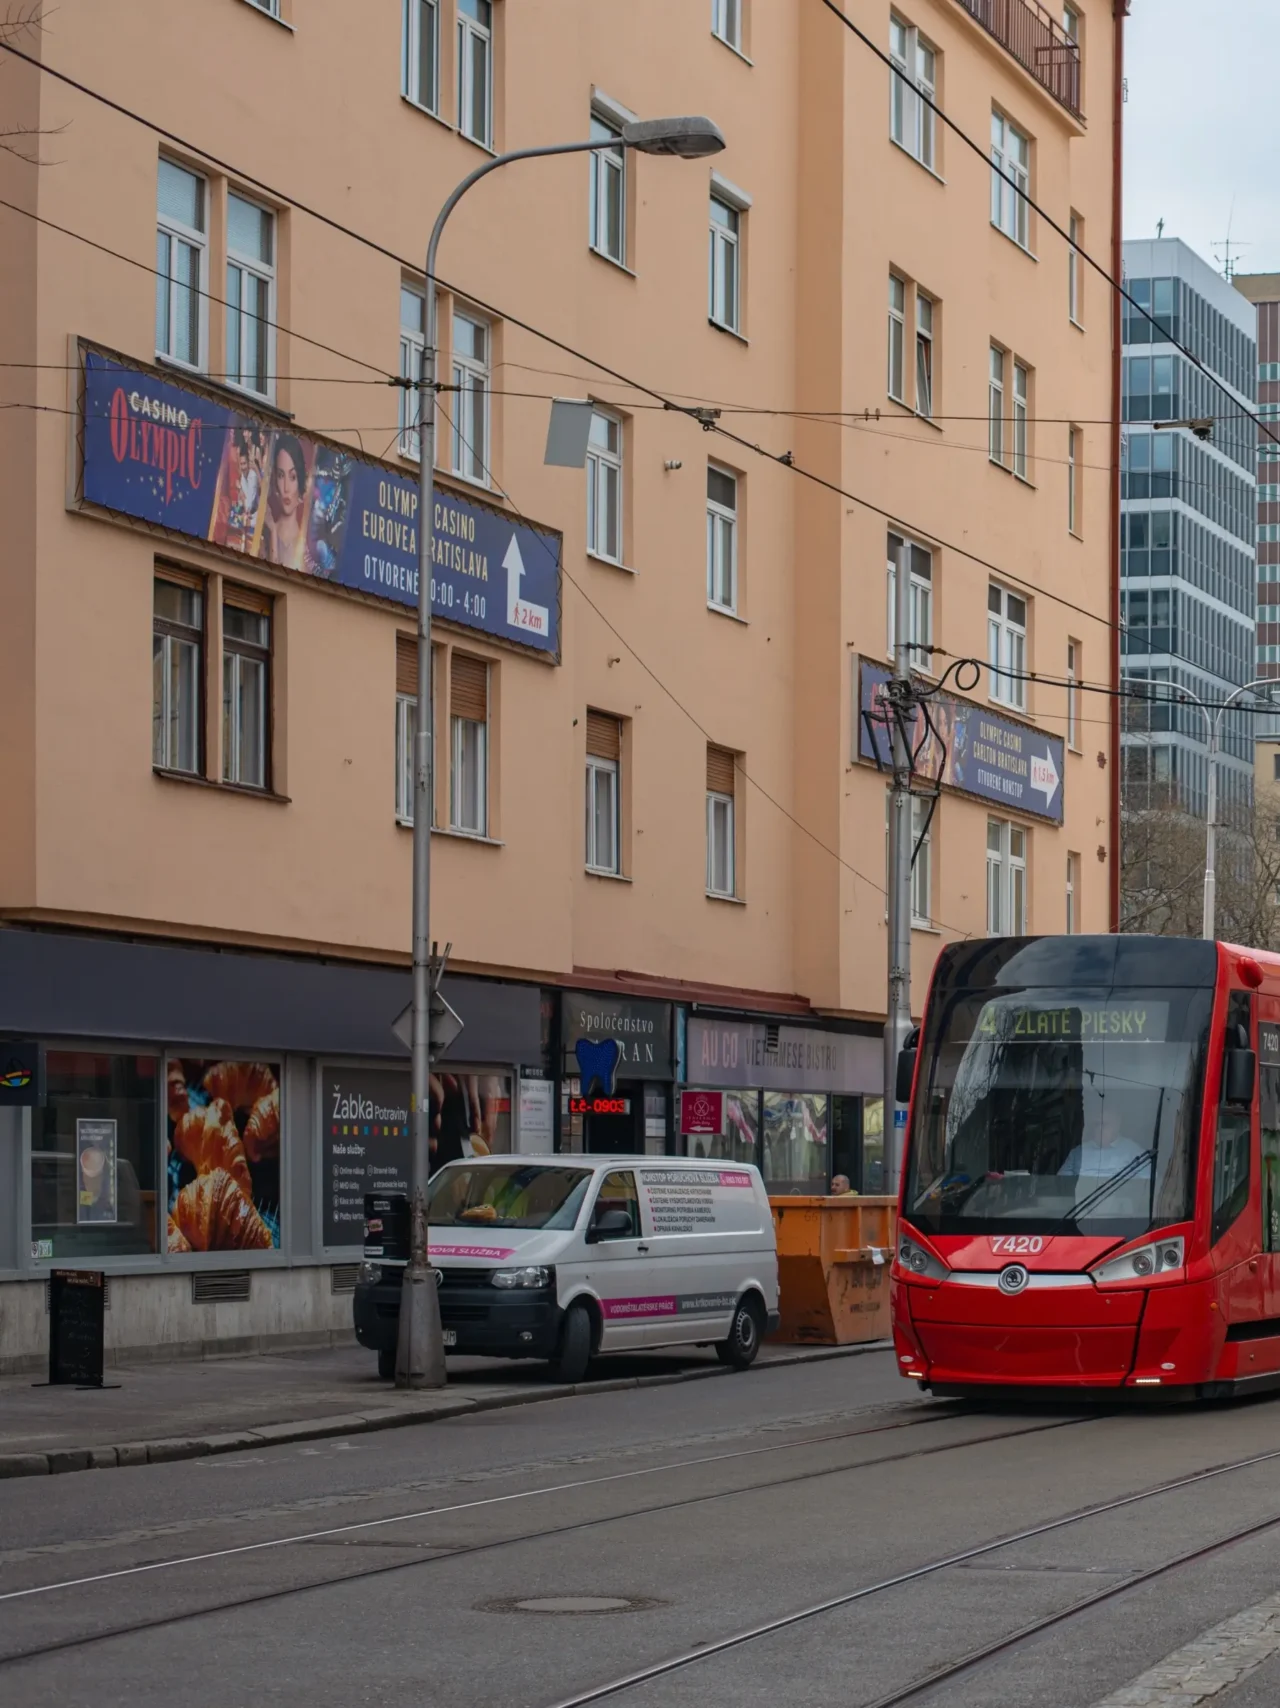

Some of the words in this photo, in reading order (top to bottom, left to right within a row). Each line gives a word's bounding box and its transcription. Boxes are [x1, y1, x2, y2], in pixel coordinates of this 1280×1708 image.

[130, 391, 187, 429] CASINO
[379, 480, 418, 519] OLYMP
[434, 503, 475, 543] CASINO
[363, 510, 416, 554] EUROVEA
[431, 536, 488, 581] RATISLAVA
[364, 554, 419, 595] OTVORENÉ
[431, 578, 453, 607] 0:00
[464, 591, 486, 619] 4:00
[522, 608, 527, 625] 2
[529, 610, 542, 630] km
[580, 1011, 653, 1034] Spoločenstvo
[979, 1007, 996, 1034] 4
[1015, 1006, 1071, 1034] ZLATÉ
[1081, 1010, 1147, 1034] PIESKY
[1263, 1032, 1278, 1052] 7420
[806, 1044, 837, 1071] BISTRO
[333, 1084, 373, 1119] Žabka
[374, 1105, 408, 1124] Potraviny
[332, 1143, 346, 1154] Naše
[347, 1143, 365, 1156] služby:
[642, 1172, 667, 1181] NONSTOP
[992, 1236, 1043, 1253] 7420
